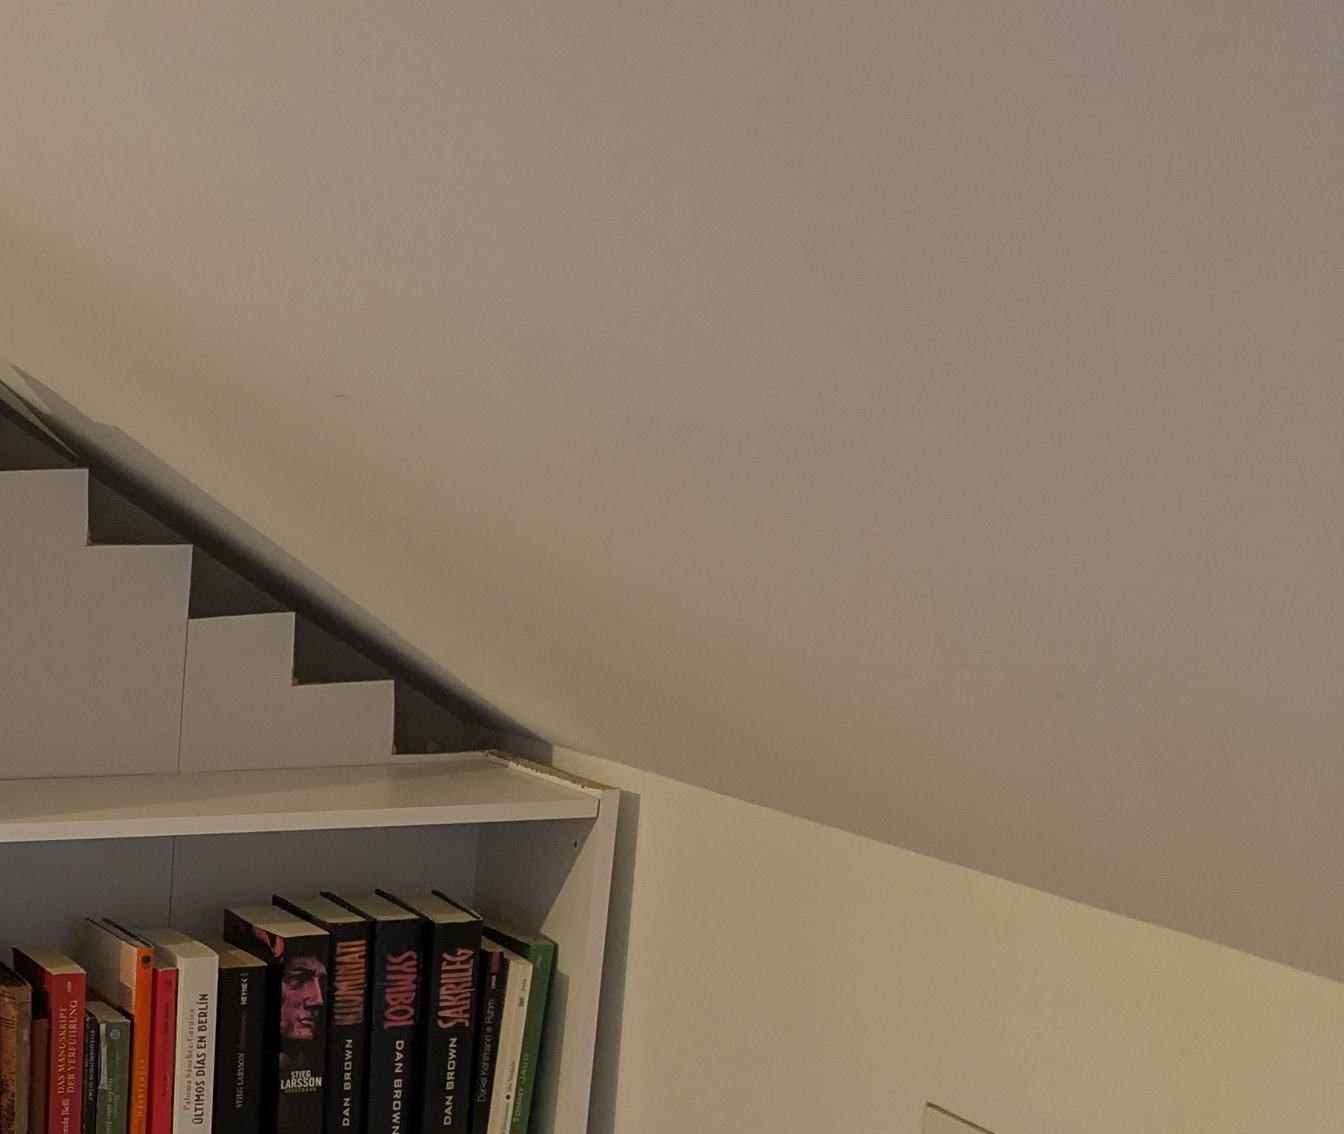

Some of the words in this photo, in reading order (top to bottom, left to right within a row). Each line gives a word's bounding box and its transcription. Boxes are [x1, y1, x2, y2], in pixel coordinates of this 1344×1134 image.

[386, 950, 417, 1029] SYMBOL
[437, 947, 474, 1029] SAKRILEG
[198, 993, 209, 1035] BERLÍN
[197, 1036, 207, 1051] EN
[395, 1040, 404, 1072] DAN
[195, 1053, 206, 1076] DÍAS
[291, 1071, 311, 1079] STIEG
[343, 1039, 353, 1091] BROWN
[281, 1078, 322, 1089] LARSSON
[192, 1078, 205, 1126] ÚLTIMOS
[342, 1098, 351, 1127] DAN
